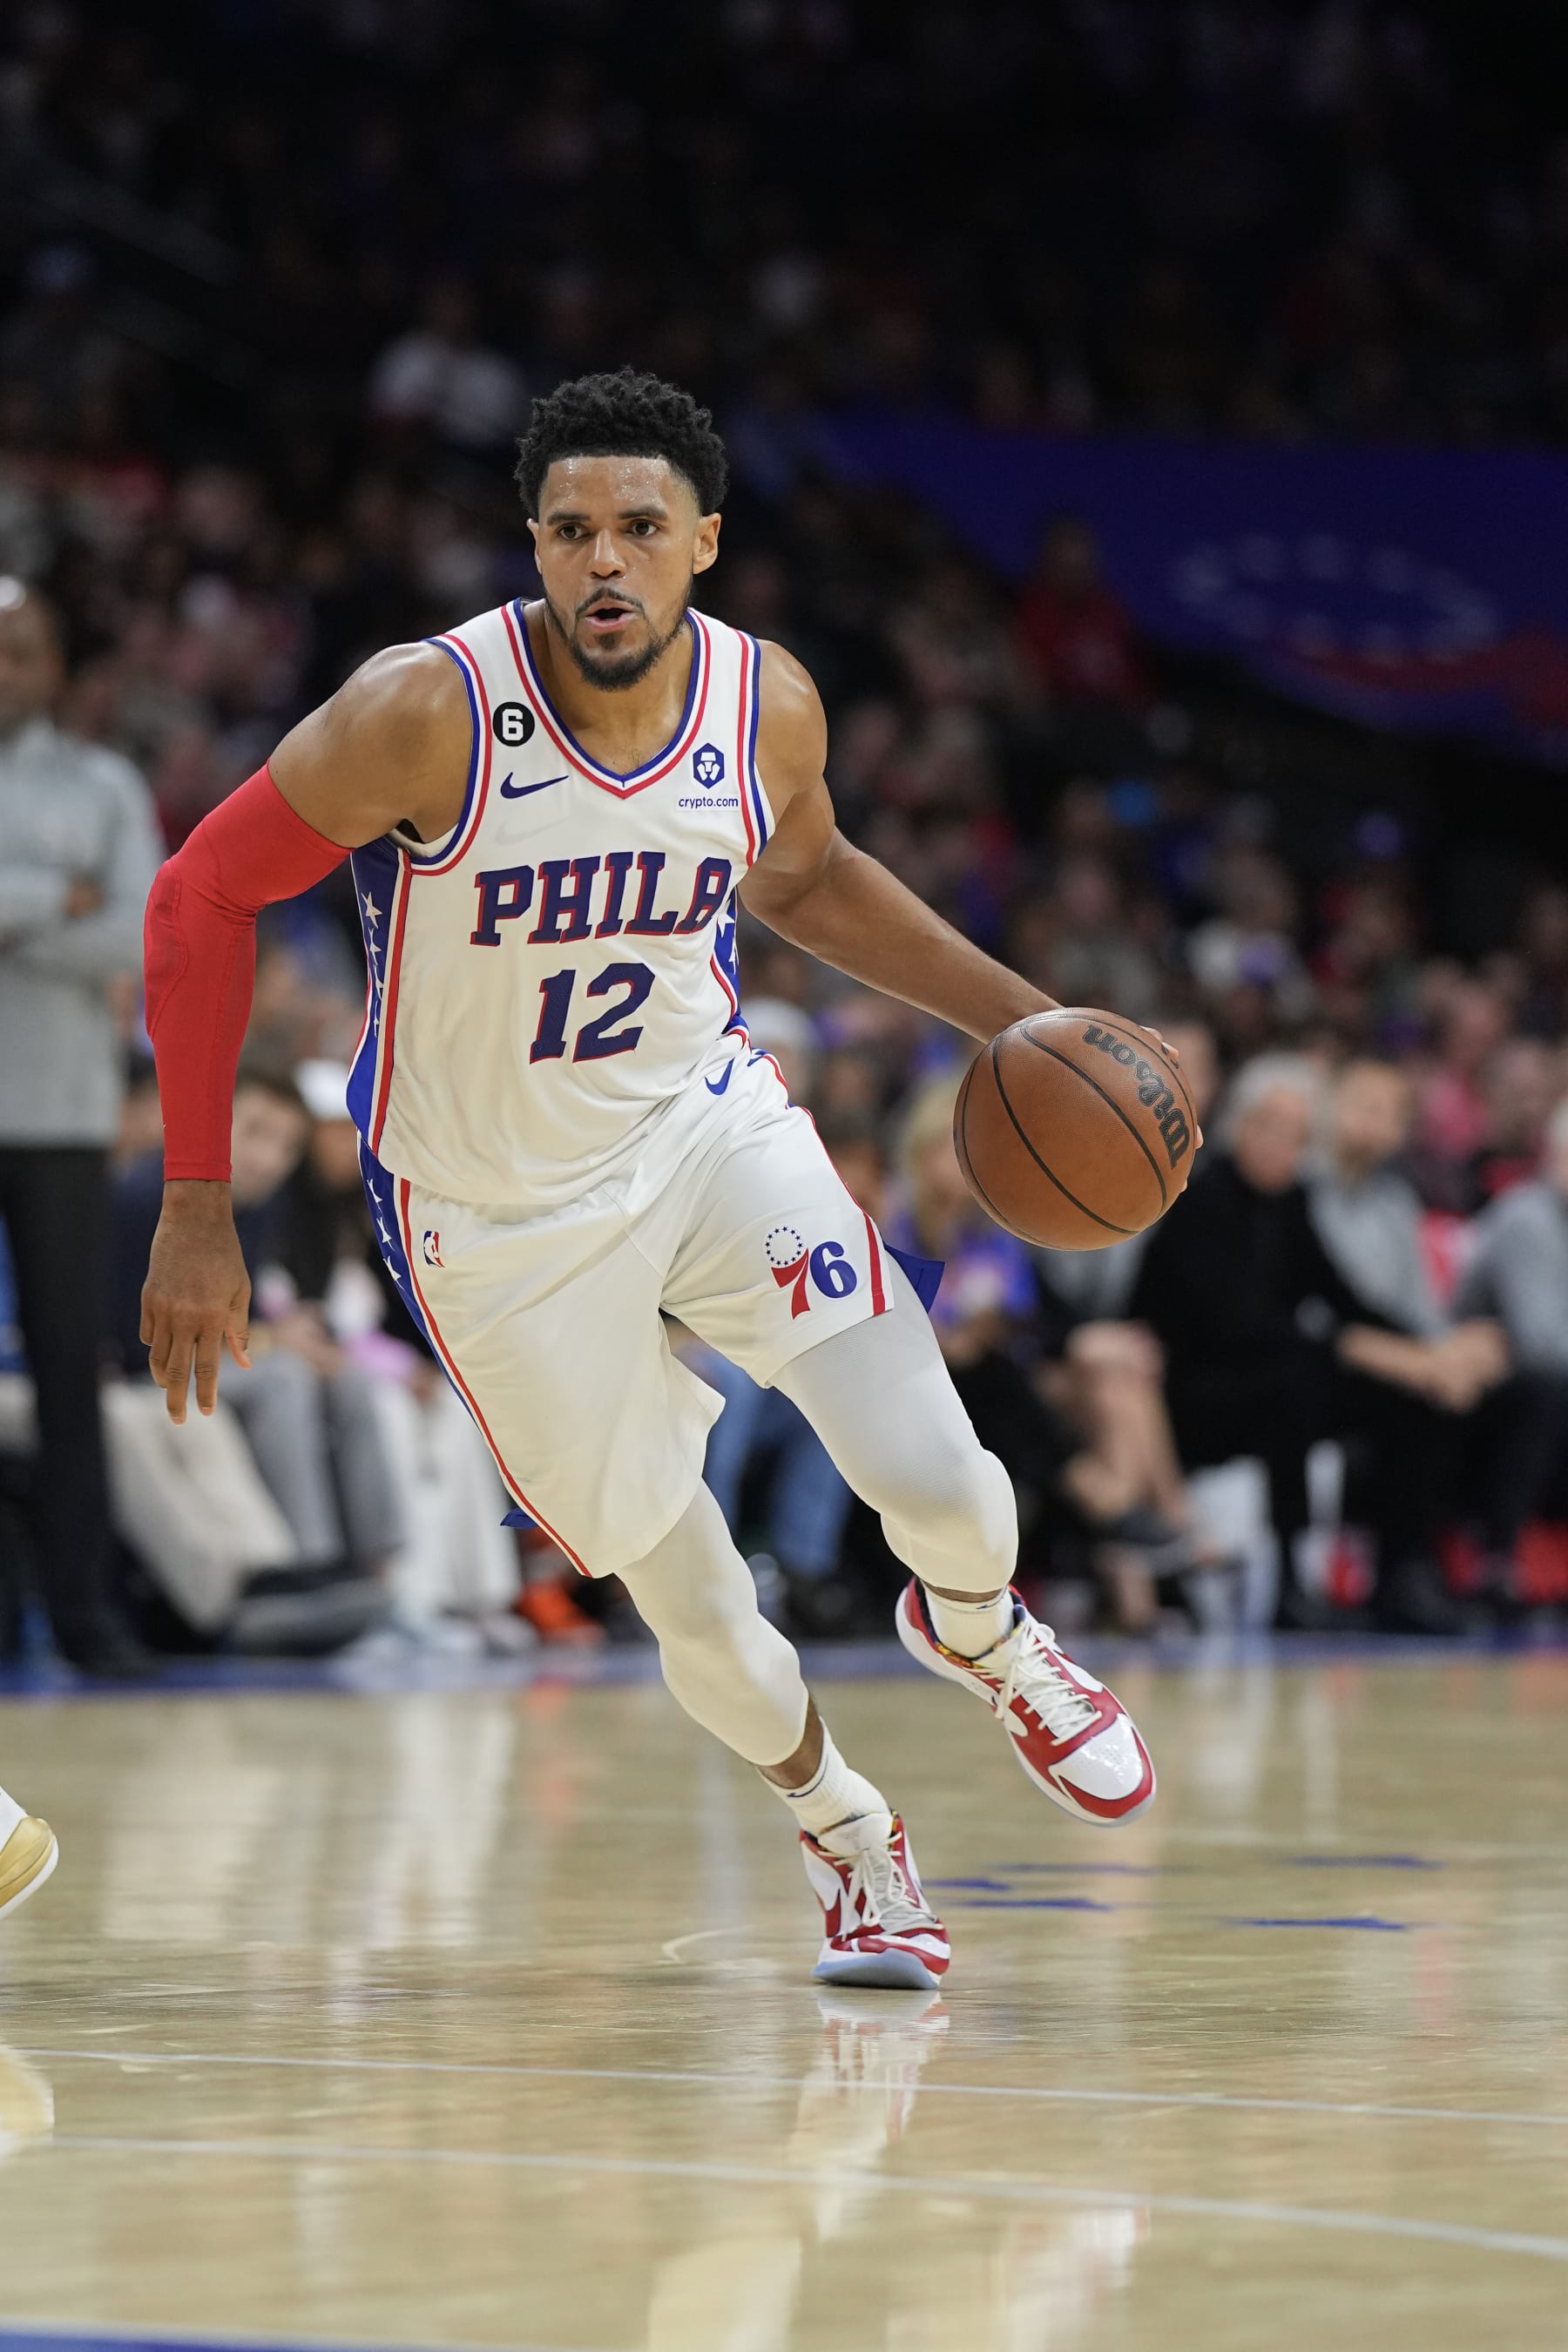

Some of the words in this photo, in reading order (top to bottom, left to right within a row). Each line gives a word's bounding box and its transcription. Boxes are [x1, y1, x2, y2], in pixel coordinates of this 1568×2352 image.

[502, 708, 523, 740] 6
[679, 796, 739, 809] crypto.com
[470, 851, 732, 947] PHILA
[529, 963, 656, 1064] 12
[1082, 1024, 1190, 1170] Wilson
[770, 1240, 857, 1321] 76
